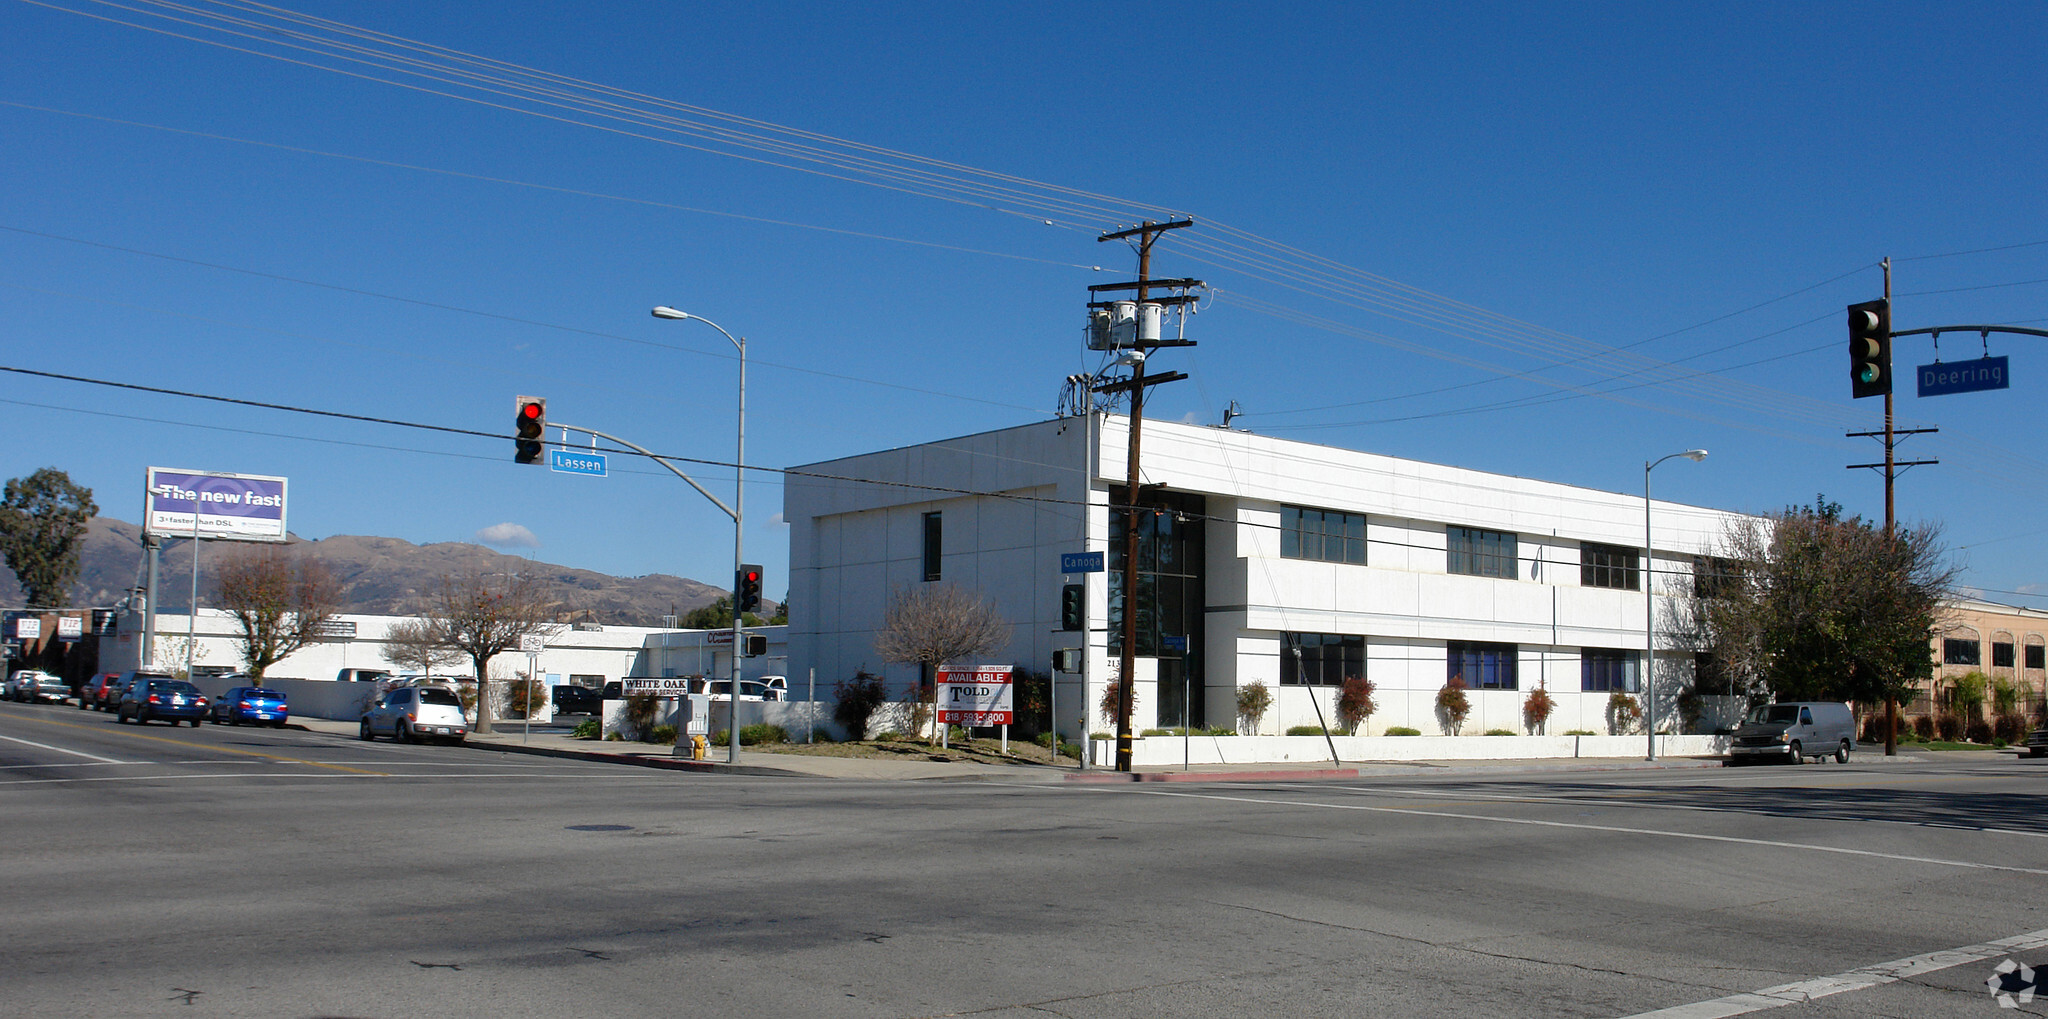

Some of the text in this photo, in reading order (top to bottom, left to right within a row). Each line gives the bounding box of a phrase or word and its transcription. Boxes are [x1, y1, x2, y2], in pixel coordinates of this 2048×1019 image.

[1924, 366, 2002, 387] Deering
[557, 455, 601, 471] Lassen
[159, 484, 282, 507] The new fast
[169, 516, 194, 524] faster
[216, 519, 233, 527] DSL
[1064, 556, 1101, 569] Canoga
[63, 619, 79, 628] VIP
[625, 680, 686, 688] WHITE OAK
[946, 673, 1004, 682] AVAILABLE
[950, 686, 990, 702] TOLD
